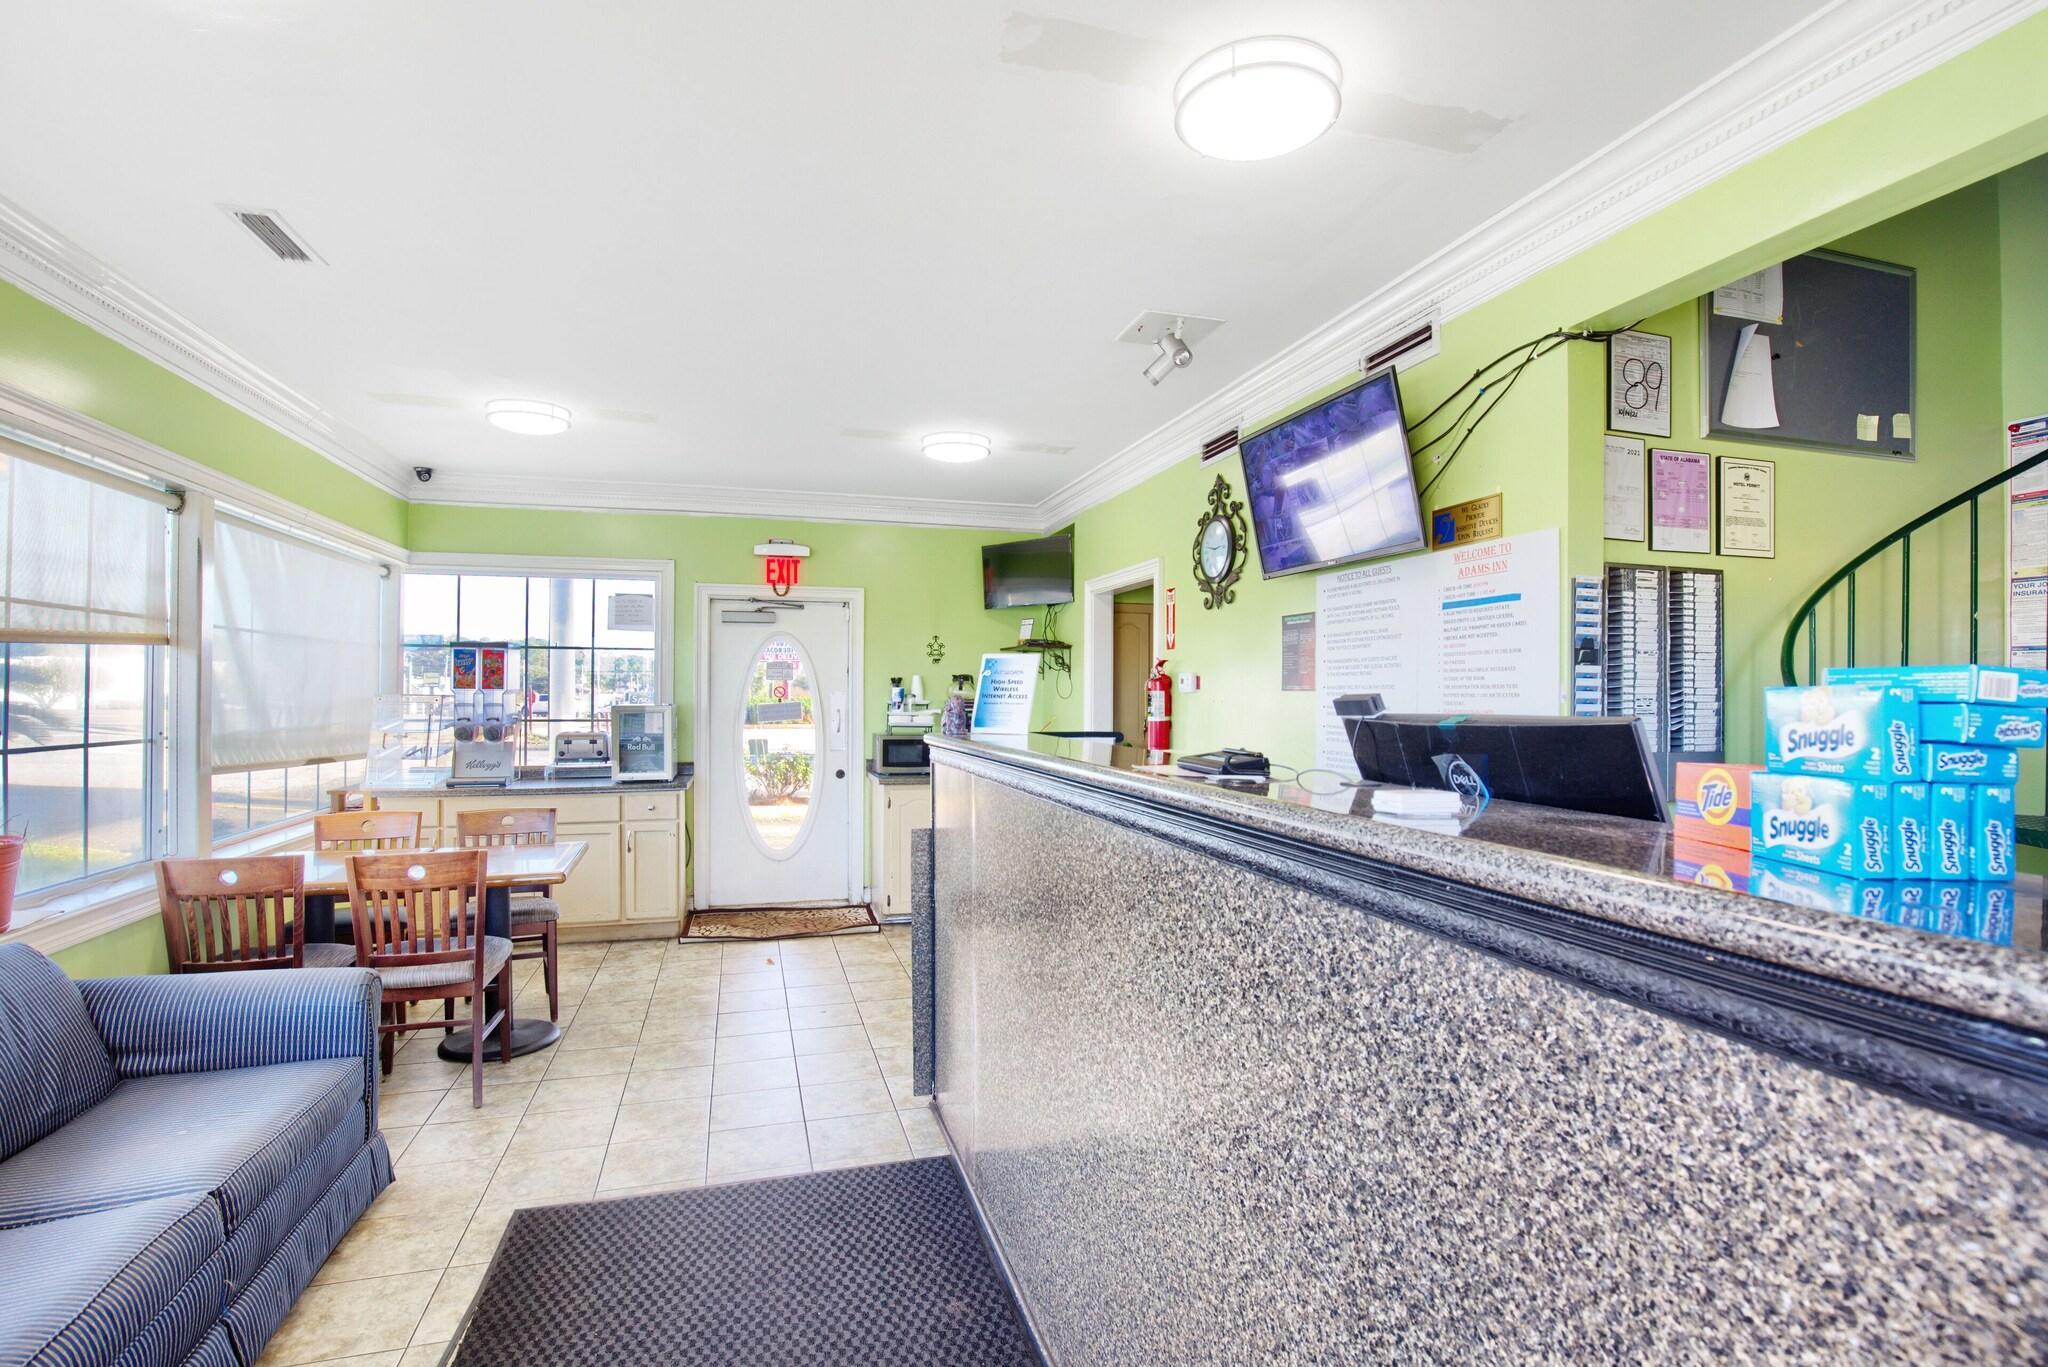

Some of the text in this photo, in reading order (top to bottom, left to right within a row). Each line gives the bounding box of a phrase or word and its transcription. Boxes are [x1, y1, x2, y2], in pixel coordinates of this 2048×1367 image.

[1623, 358, 1663, 412] 89
[1627, 448, 1640, 457] 2021
[1680, 456, 1700, 464] ALABAMA
[1454, 543, 1512, 562] WELCOME TO
[767, 559, 800, 584] EXIT
[1337, 572, 1354, 583] NOTICE
[1362, 569, 1371, 577] ALL
[1372, 565, 1392, 576] GUESTS
[1458, 559, 1509, 577] ADAMS INN
[628, 743, 655, 751] Red Bull
[1787, 723, 1855, 753] Snuggle
[1889, 722, 1911, 774] Snuggle
[465, 760, 501, 771] Kellogg's
[1939, 753, 1986, 769] Snuggle
[1453, 774, 1477, 786] DELL
[1702, 782, 1733, 812] Tide
[1770, 816, 1830, 842] Snuggle
[1862, 820, 1882, 871] Snuggle
[1901, 820, 1920, 871] Snuggle
[1941, 821, 1959, 873] Snuggle
[1987, 822, 2006, 874] Snuggle
